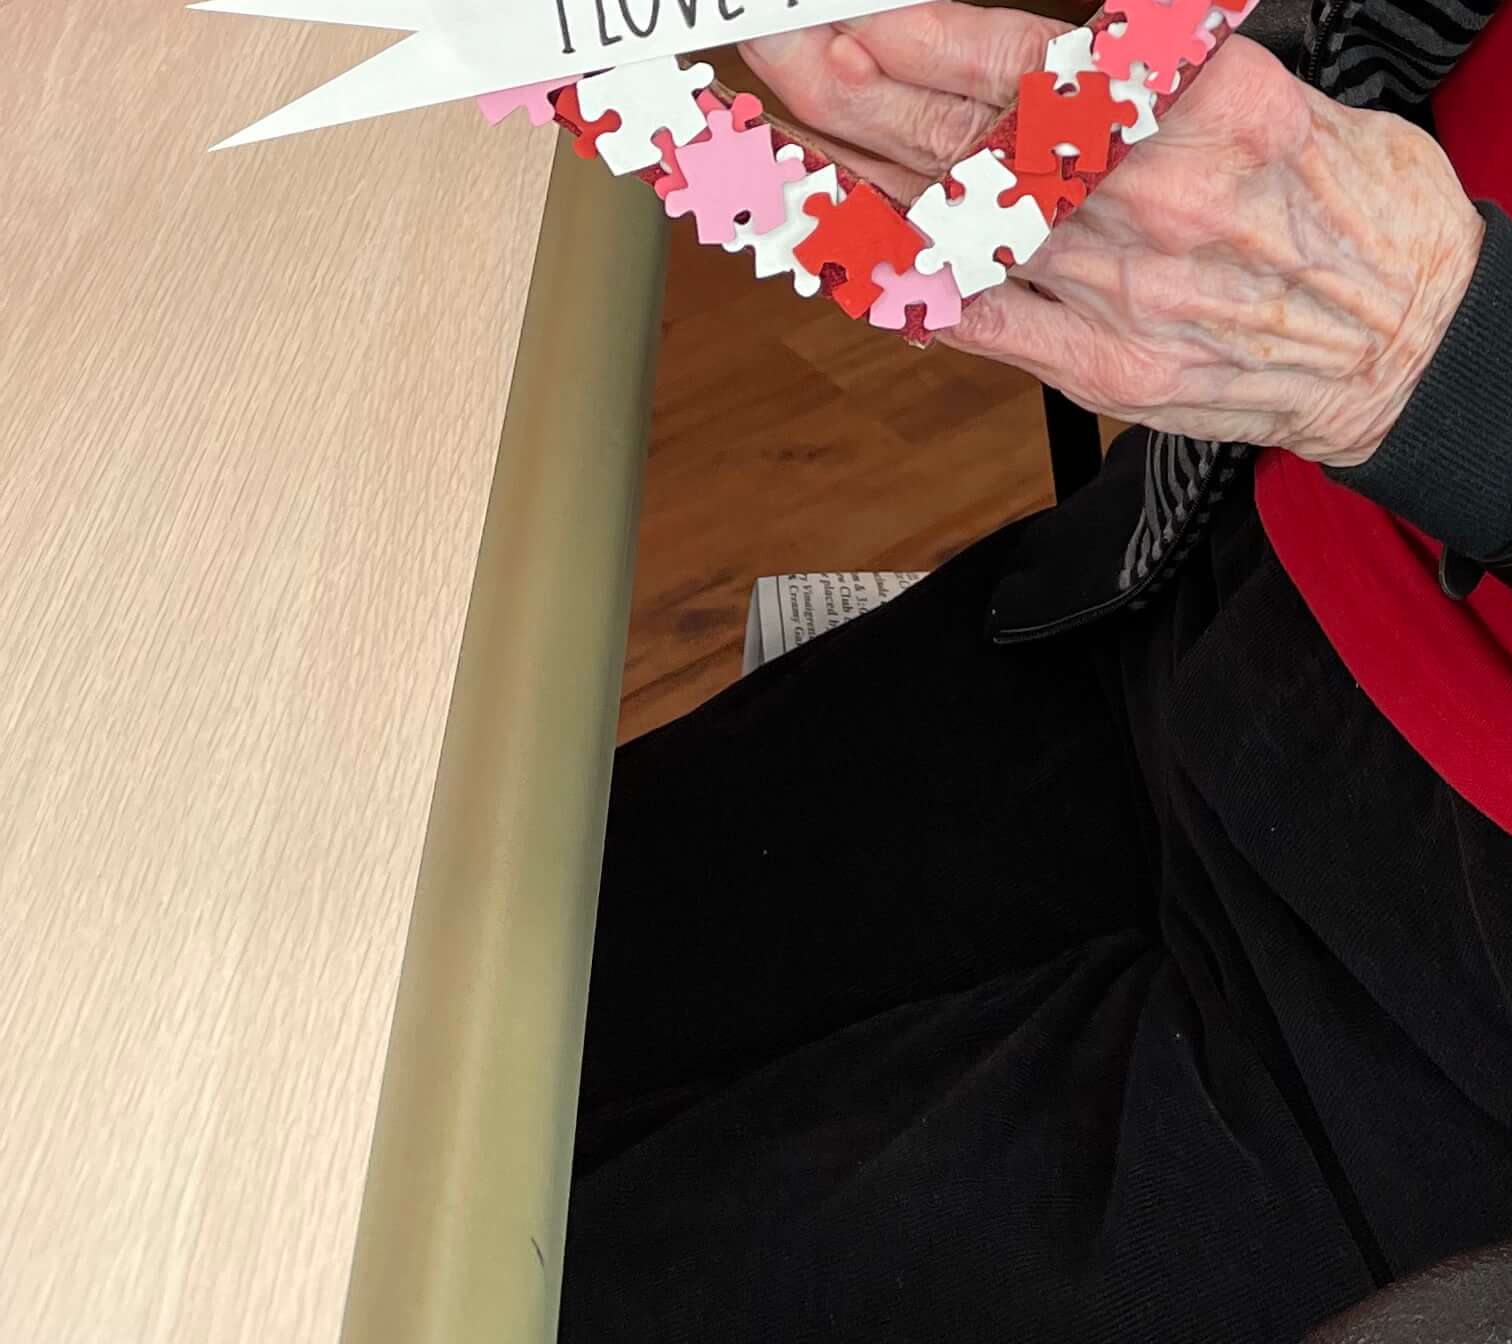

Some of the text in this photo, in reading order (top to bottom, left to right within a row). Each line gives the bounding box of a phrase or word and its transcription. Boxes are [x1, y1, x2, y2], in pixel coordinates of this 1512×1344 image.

[789, 584, 801, 623] Creamy
[819, 579, 839, 616] placed
[840, 585, 853, 613] Club
